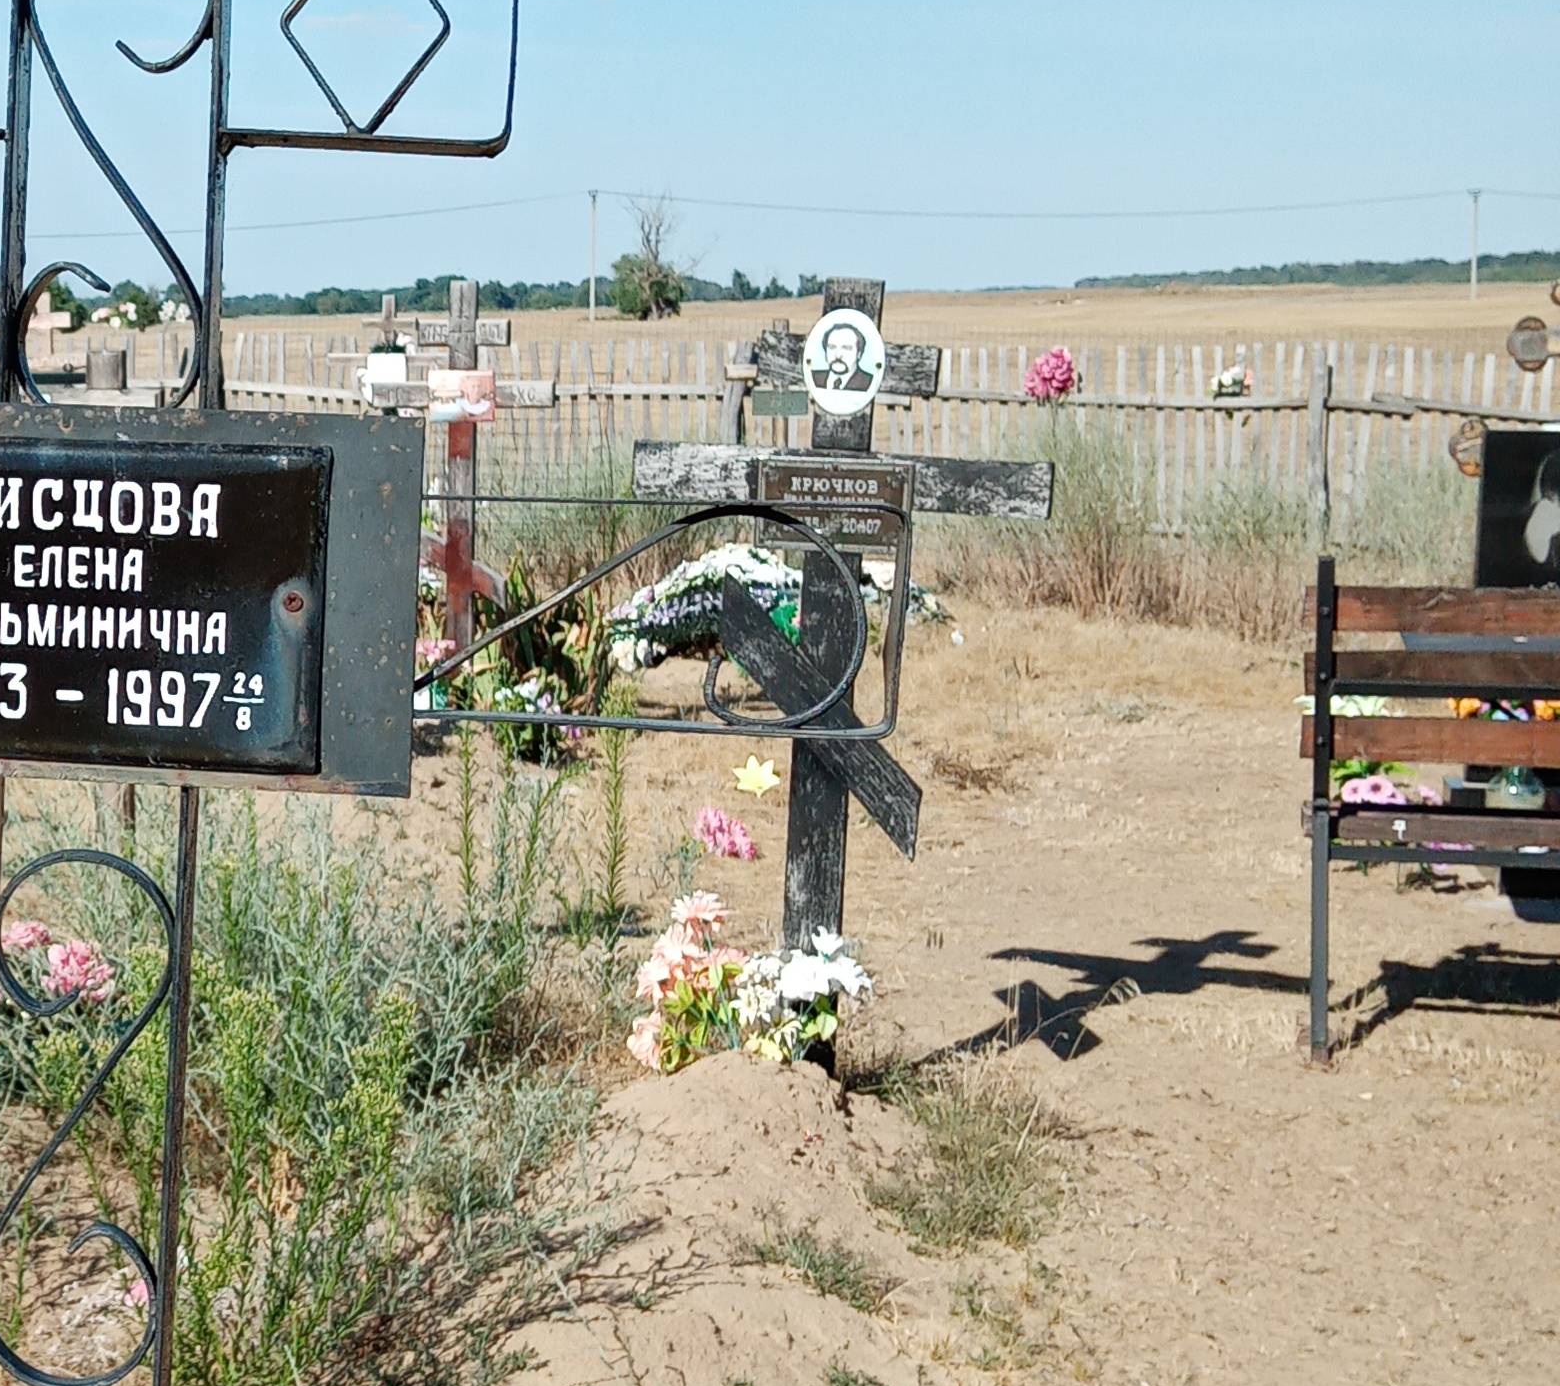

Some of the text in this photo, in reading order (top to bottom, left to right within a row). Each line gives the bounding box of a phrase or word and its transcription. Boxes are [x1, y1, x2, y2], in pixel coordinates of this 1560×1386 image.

[791, 476, 879, 494] КРЮЧКОВ
[13, 544, 144, 593] ЕЛЕНА
[106, 667, 221, 729] 1997
